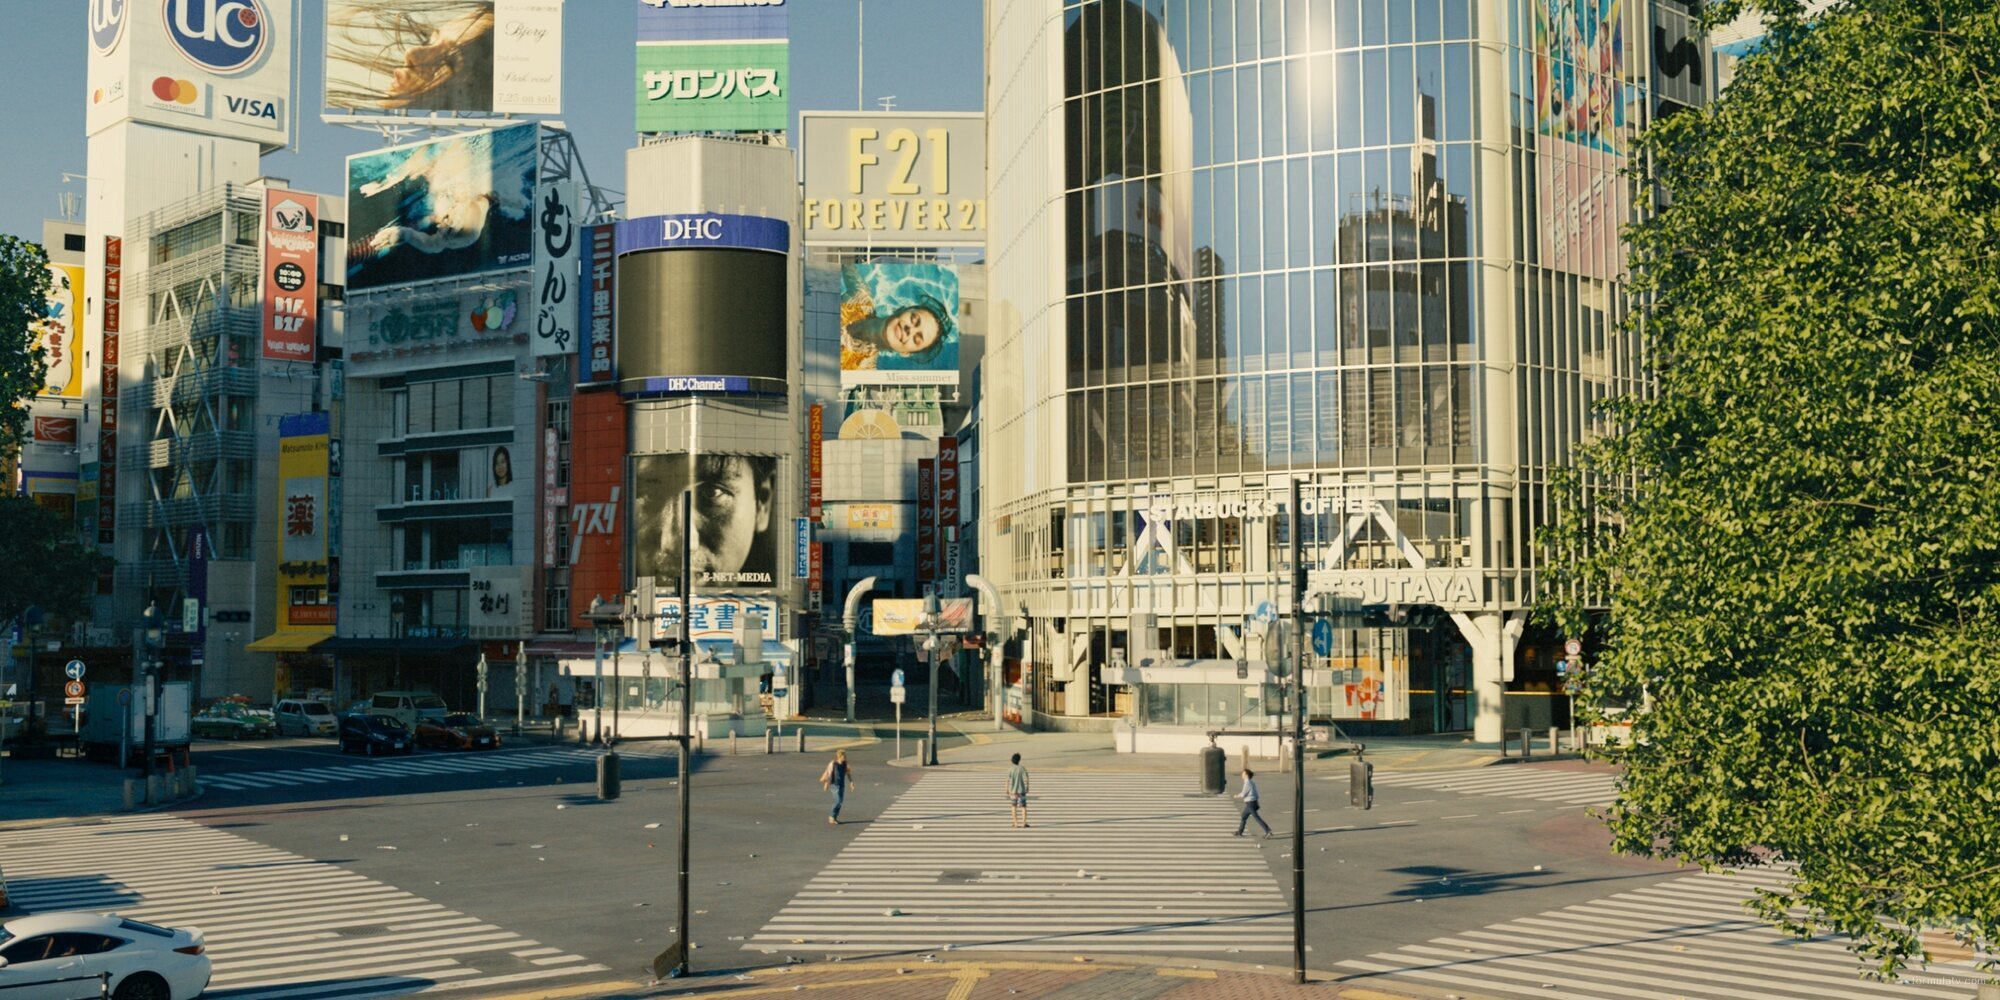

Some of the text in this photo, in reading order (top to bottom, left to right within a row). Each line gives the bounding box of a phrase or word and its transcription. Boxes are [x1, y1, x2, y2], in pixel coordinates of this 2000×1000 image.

[643, 67, 780, 99] サロンパス
[225, 95, 277, 120] VISA
[850, 128, 948, 194] F21
[663, 218, 722, 241] DHC
[806, 200, 949, 231] FOREVER
[541, 187, 572, 351] もんじゃ
[274, 296, 304, 314] B1F
[592, 231, 611, 373] 三千里薬品
[274, 316, 304, 333] B2F
[668, 378, 726, 391] DHC Channel
[940, 448, 957, 520] カラオケ
[287, 494, 315, 536] 薬
[1151, 502, 1278, 522] STARBUCKS
[920, 507, 933, 571] カラオケ
[703, 571, 772, 583] E-NET-MEDIA
[1316, 573, 1476, 603] TSUTAYA
